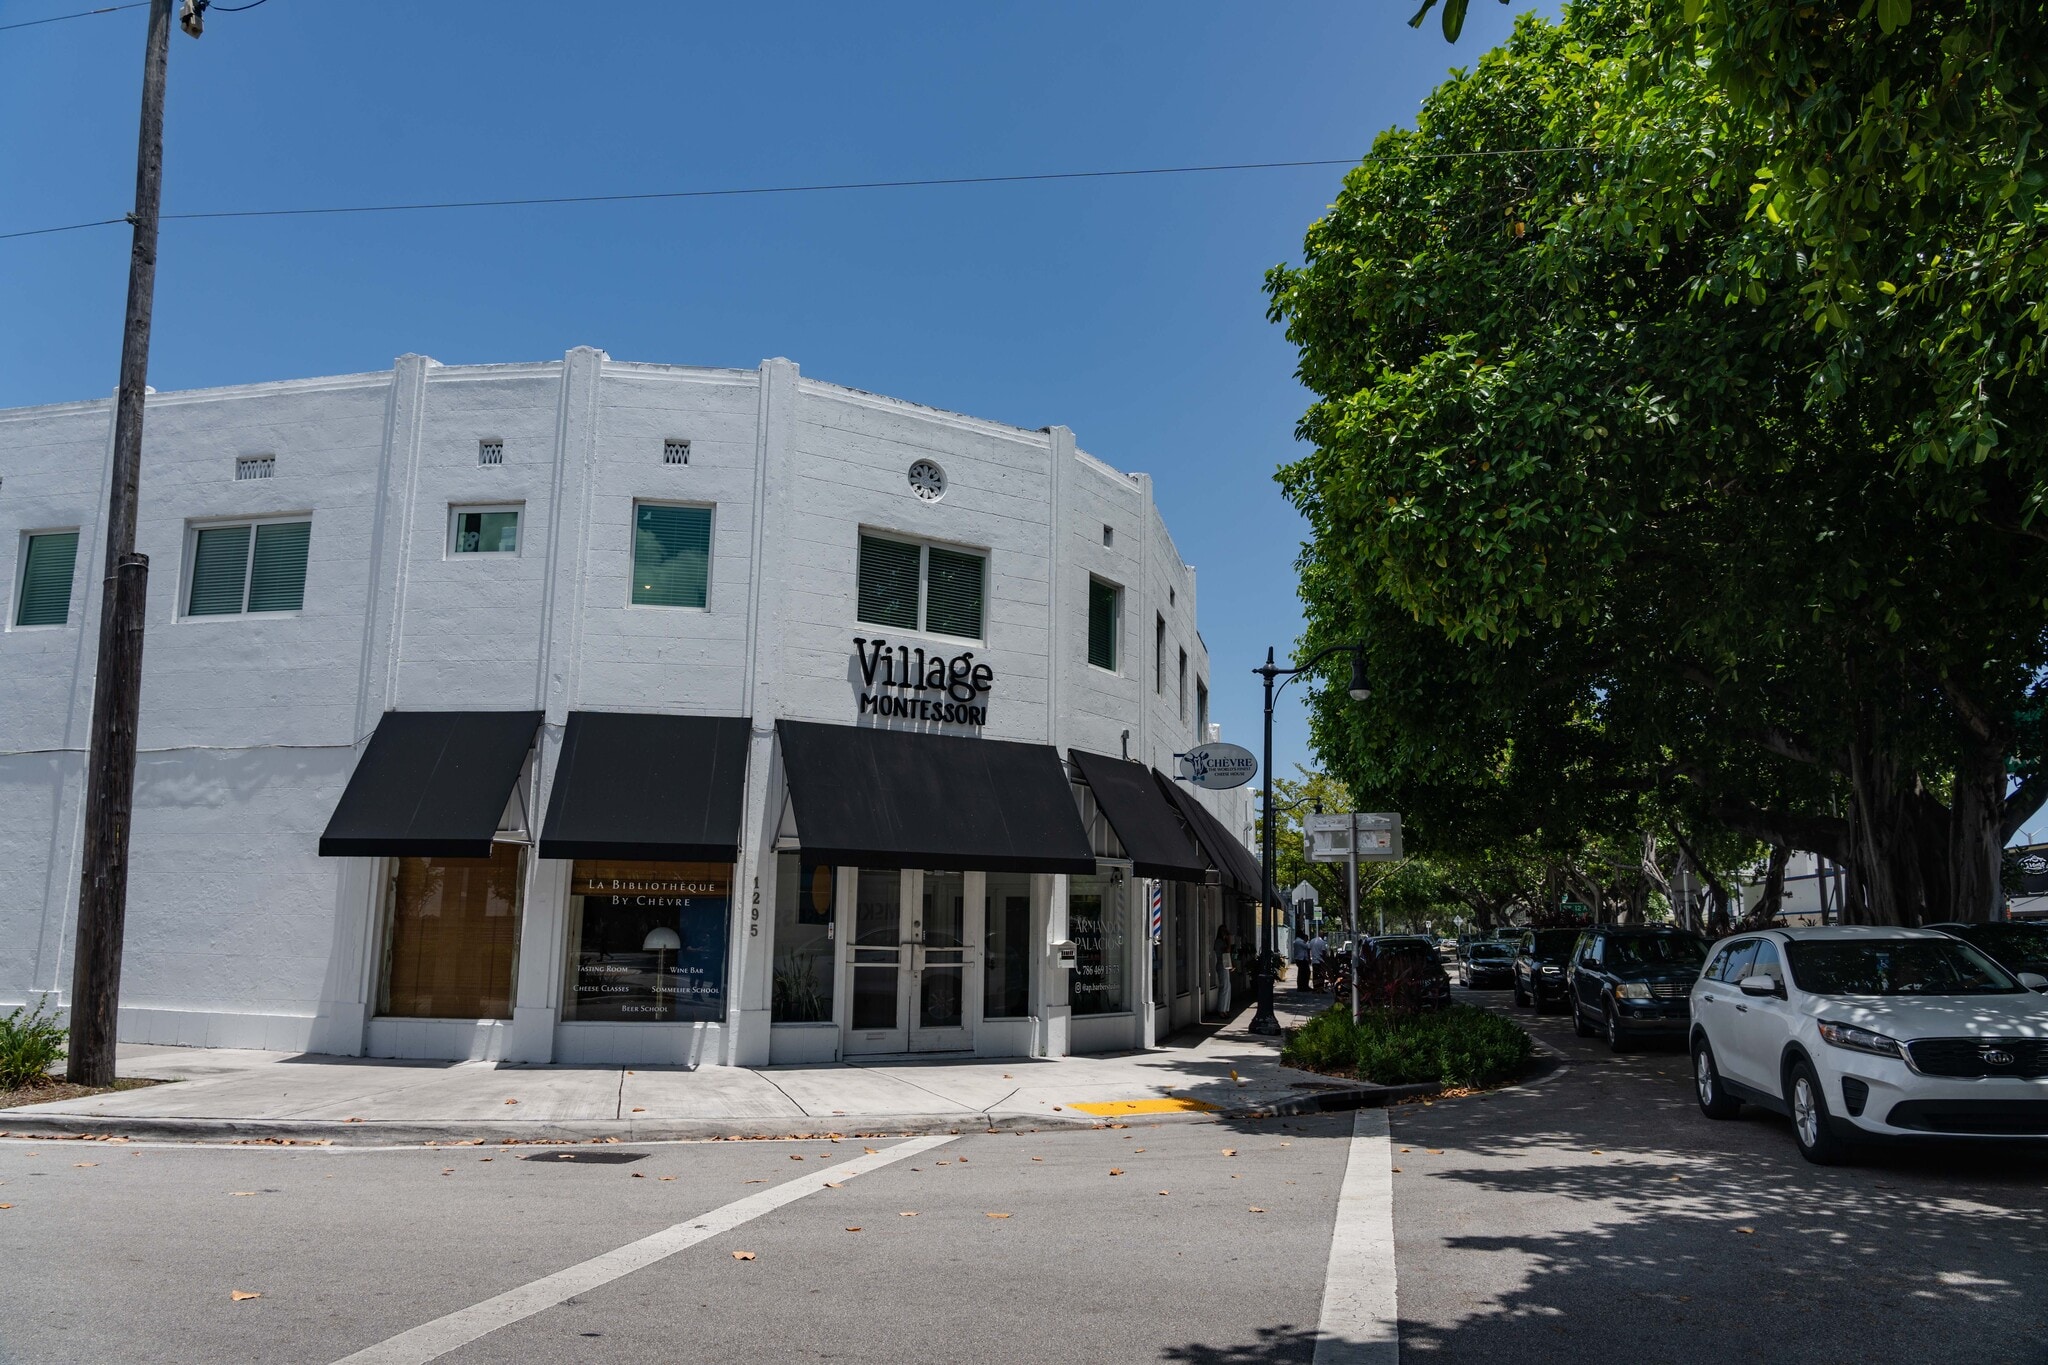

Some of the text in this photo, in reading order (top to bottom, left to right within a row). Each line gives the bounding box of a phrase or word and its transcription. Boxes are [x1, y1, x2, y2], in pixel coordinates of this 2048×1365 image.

[853, 637, 993, 702] Village
[860, 692, 986, 726] MONTESSORI
[1206, 756, 1253, 767] CHÈVRE
[589, 879, 604, 890] LA
[612, 895, 629, 905] BY
[750, 876, 760, 937] 1295
[577, 965, 628, 973] TASTING ROOM
[669, 966, 704, 974] WINE BAR
[572, 985, 630, 993] CHEESE CLASSES
[621, 1004, 669, 1013] BEER SCHOOL
